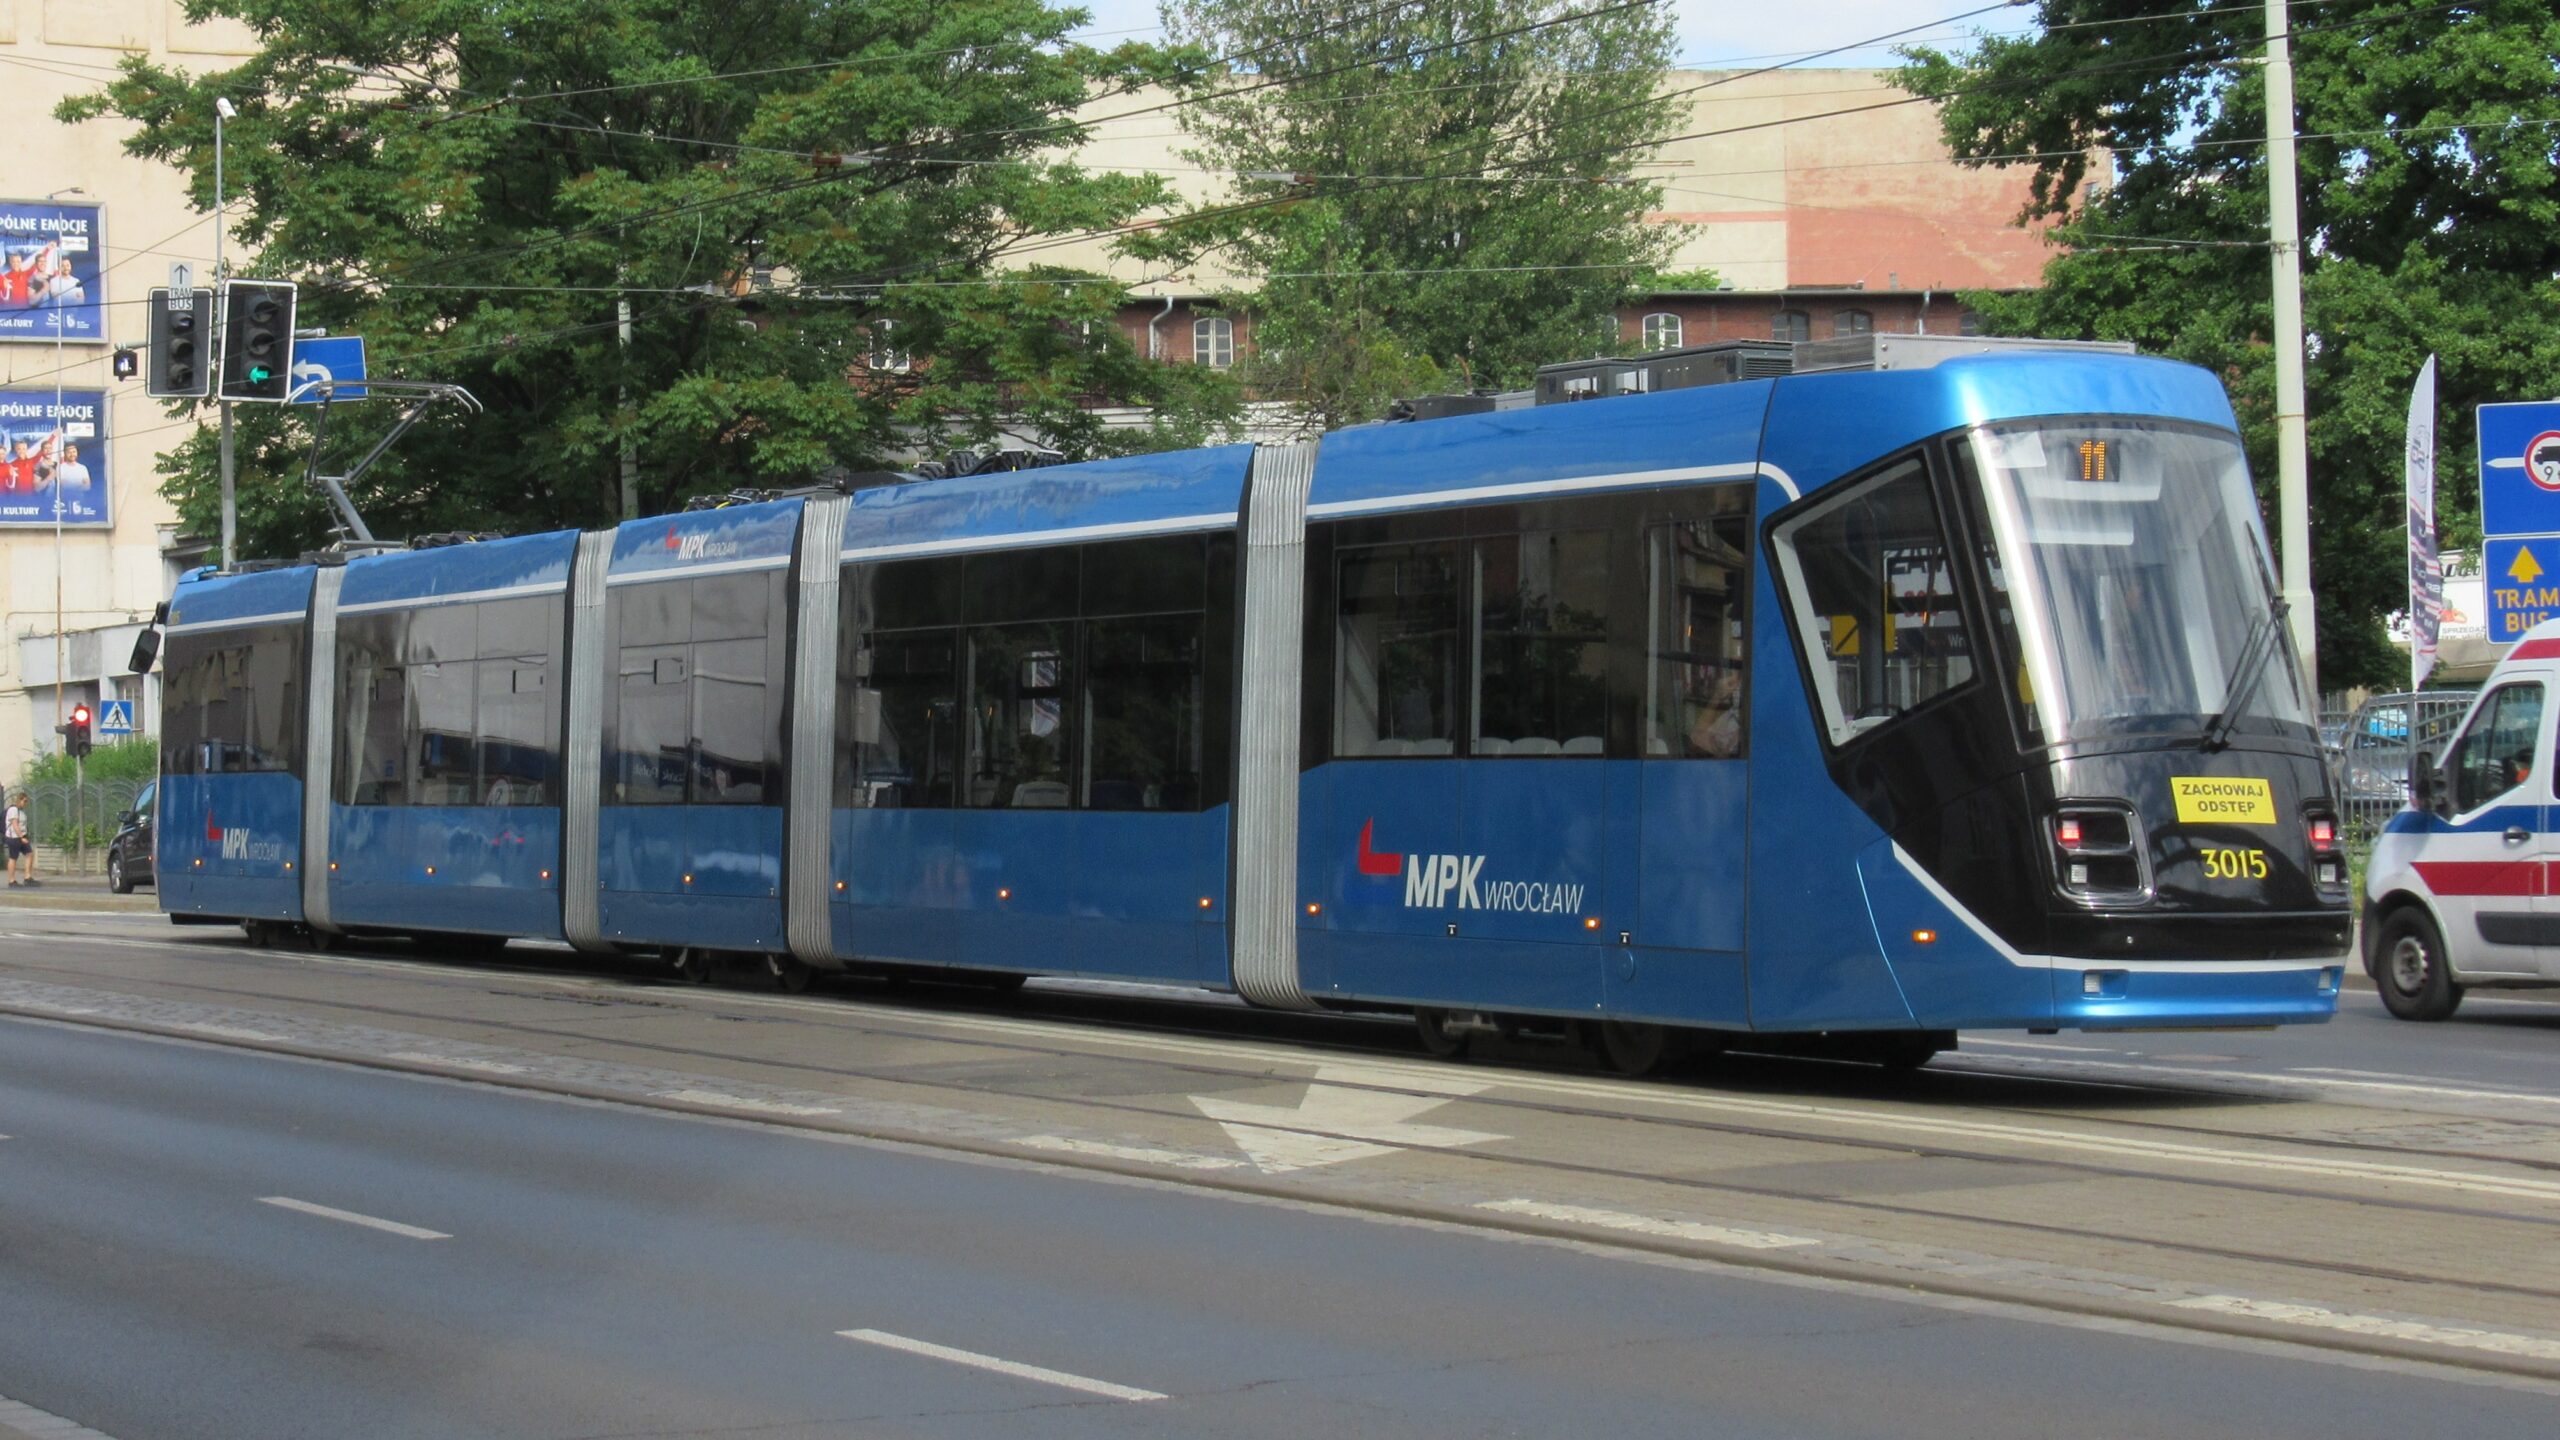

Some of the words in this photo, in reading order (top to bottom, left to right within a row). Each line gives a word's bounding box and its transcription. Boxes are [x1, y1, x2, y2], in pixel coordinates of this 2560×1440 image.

[41, 217, 88, 235] EMOCJE
[170, 287, 193, 299] TRAM
[170, 299, 193, 310] BUS
[46, 404, 94, 421] EMOCJE
[2079, 440, 2106, 480] 11
[3, 506, 40, 516] KULTURY
[677, 533, 710, 560] MPK
[2493, 587, 2560, 609] TRAM
[2181, 783, 2264, 797] ZACHOWAJ
[2197, 800, 2256, 815] ODSTĘP
[222, 827, 250, 860] MPK
[2200, 848, 2268, 880] 3015
[1404, 854, 1486, 909] MPK
[1485, 881, 1585, 914] WROCŁAW
